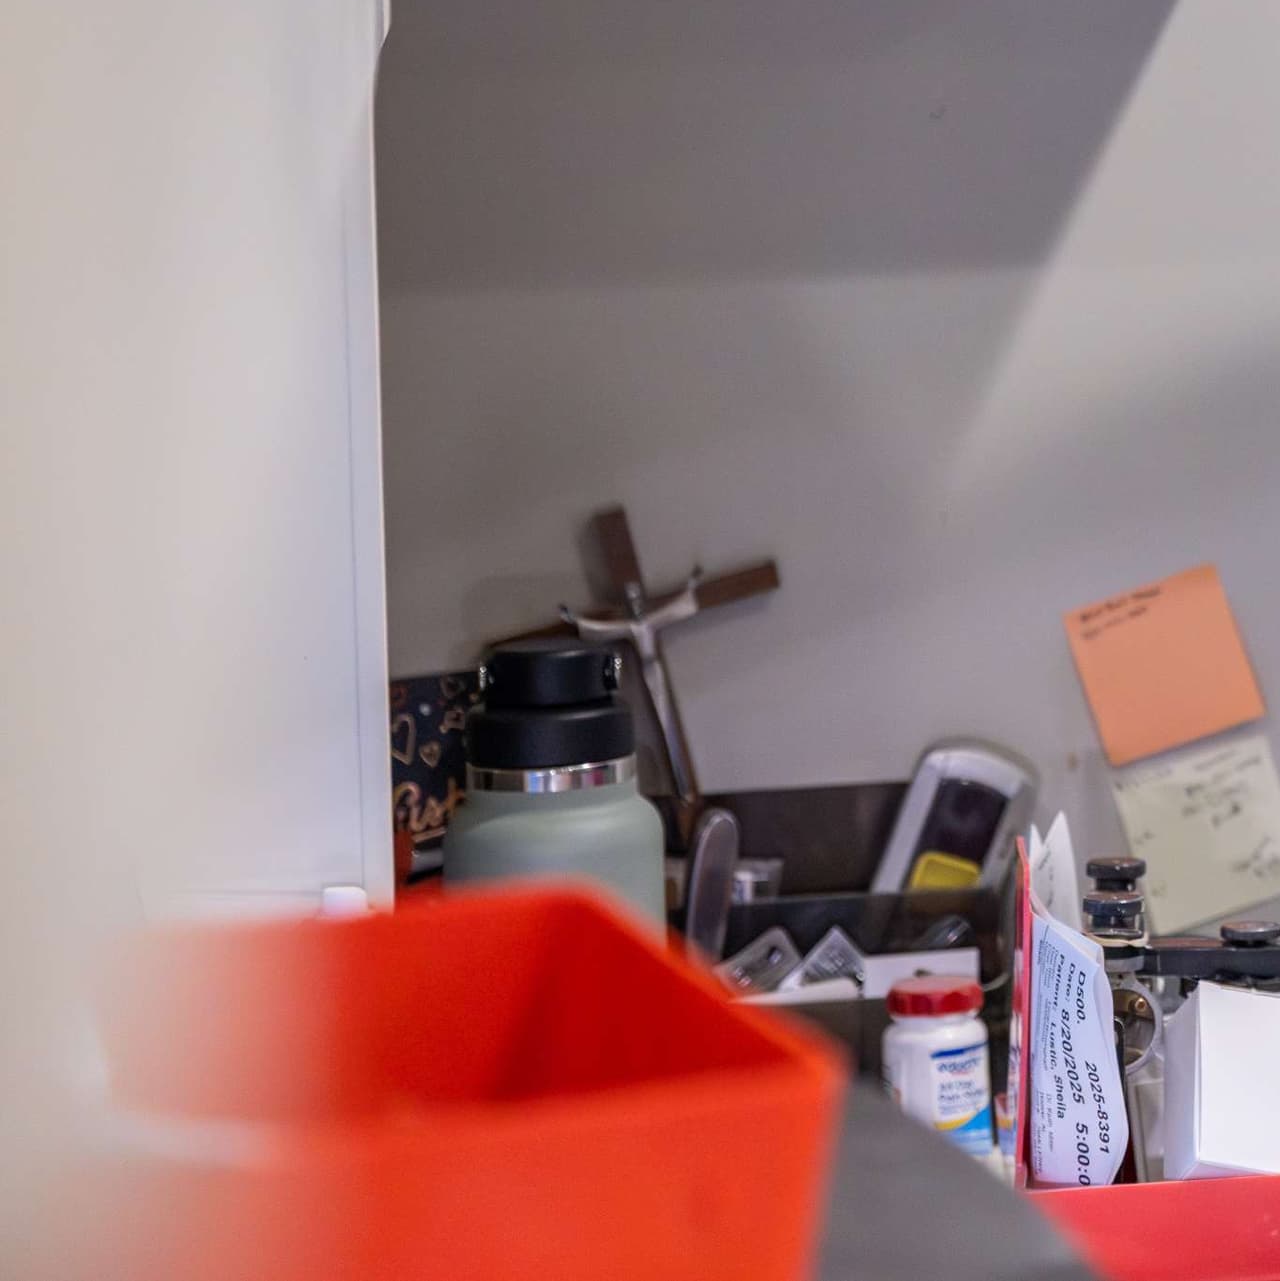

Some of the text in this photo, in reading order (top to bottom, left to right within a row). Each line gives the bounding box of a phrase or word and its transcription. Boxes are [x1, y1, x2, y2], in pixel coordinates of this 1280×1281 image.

[1053, 954, 1065, 1009] Patient:
[1063, 962, 1075, 1001] Date:
[1060, 1008, 1085, 1105] 8/20/2025
[1054, 1074, 1067, 1120] Sheila
[1085, 1060, 1110, 1154] 2025-8391
